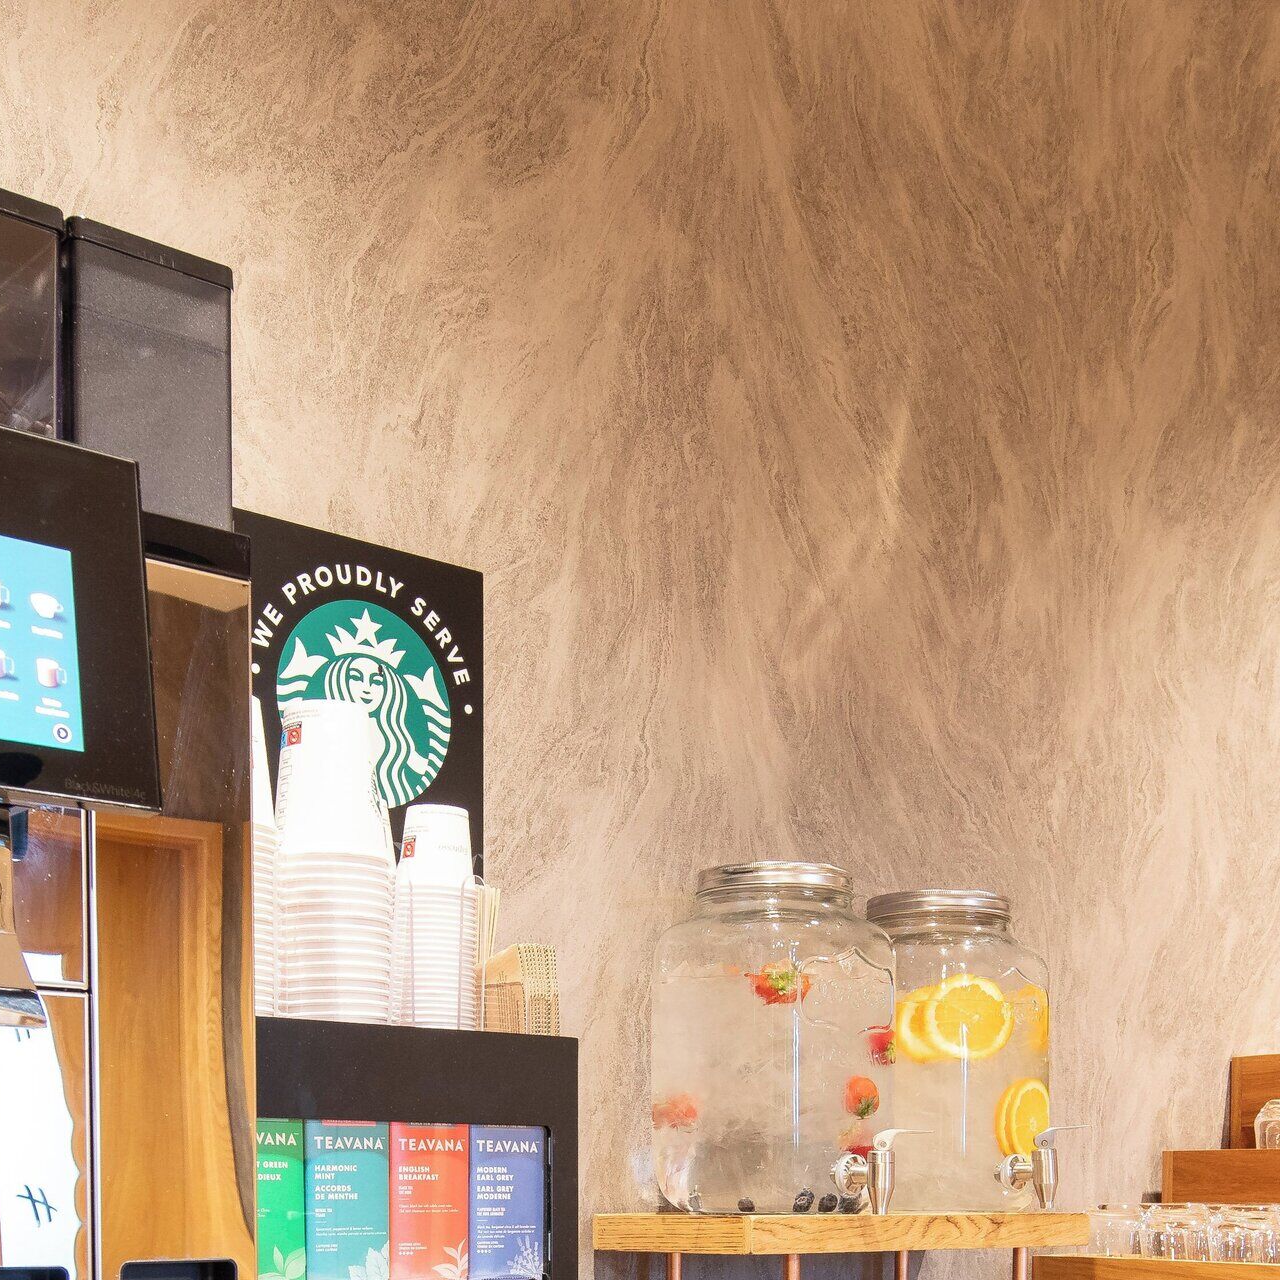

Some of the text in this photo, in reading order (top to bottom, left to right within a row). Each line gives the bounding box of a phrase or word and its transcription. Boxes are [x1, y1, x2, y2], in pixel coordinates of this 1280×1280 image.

[251, 564, 471, 686] WE PROUDLY SERVE
[257, 1132, 298, 1146] VANA
[263, 1161, 289, 1169] GREEN
[314, 1164, 358, 1172] HARMONIC
[398, 1165, 431, 1173] ENGLISH
[476, 1166, 508, 1174] MODERN
[257, 1173, 282, 1181] DIEUX
[314, 1172, 336, 1180] MINT
[398, 1173, 439, 1181] BREAKFAST
[476, 1174, 514, 1182] EARL GREY
[476, 1185, 514, 1193] EARL GREY
[476, 1193, 511, 1201] MODERNE
